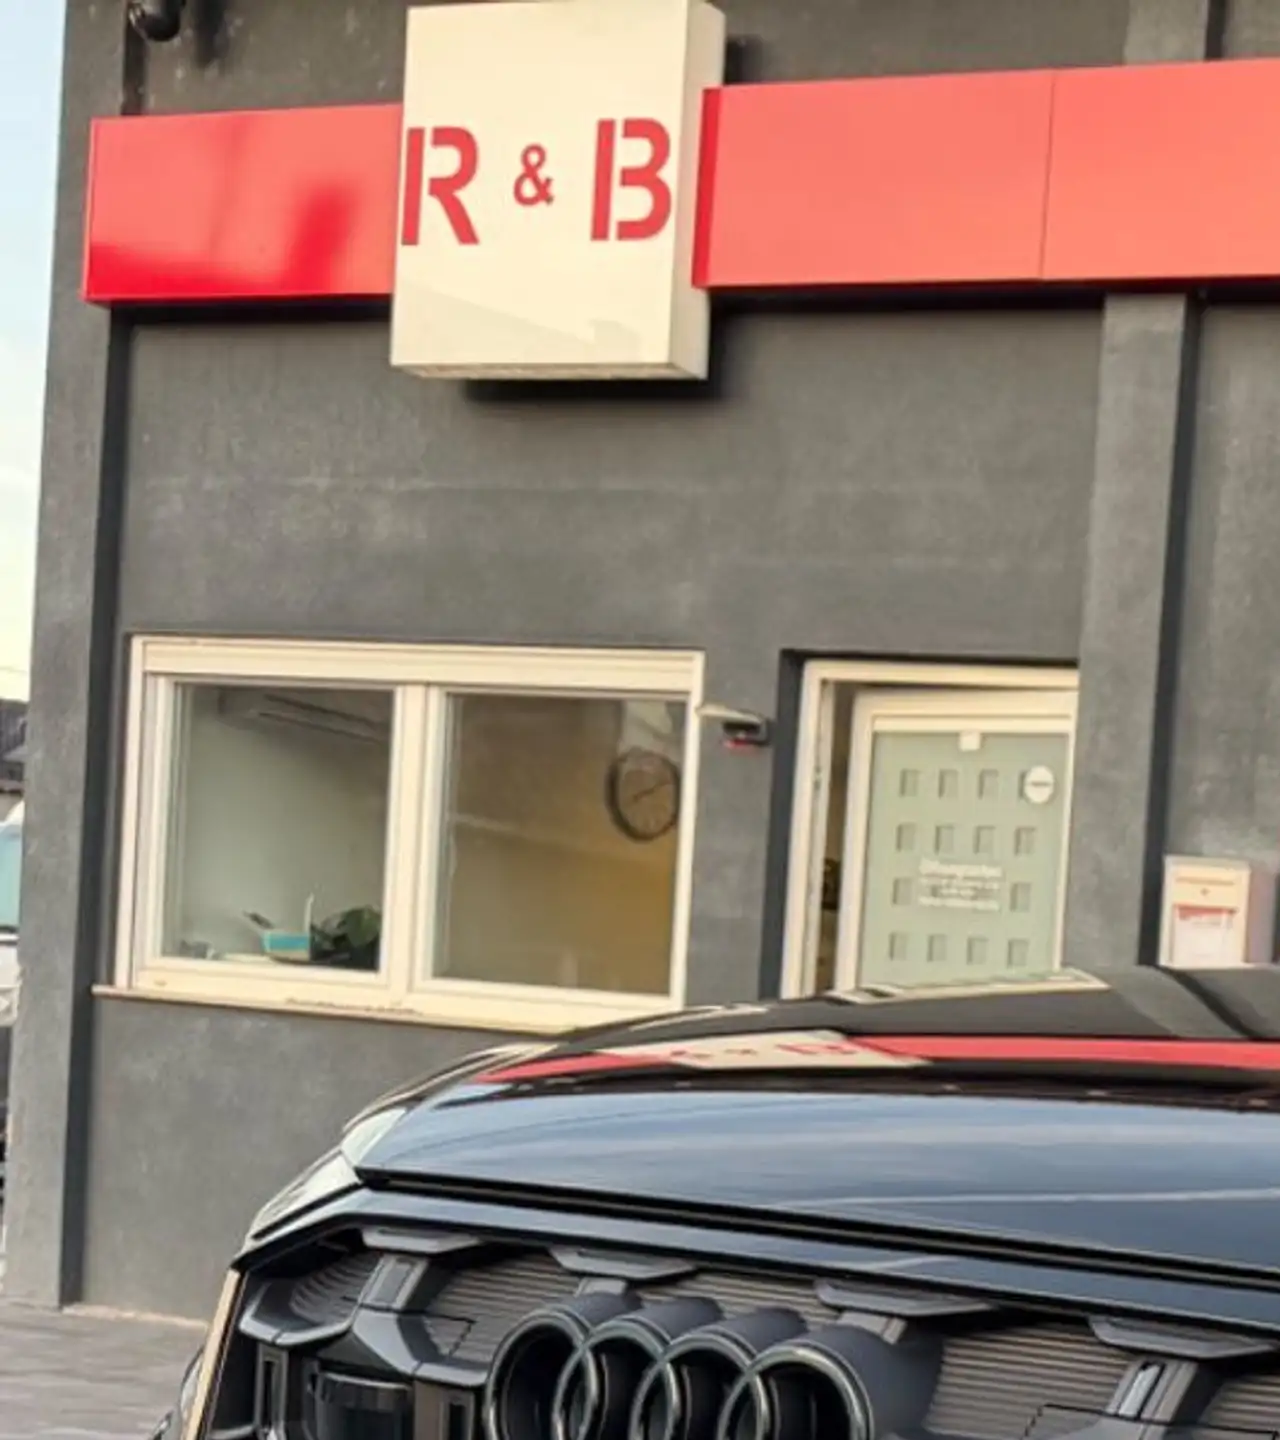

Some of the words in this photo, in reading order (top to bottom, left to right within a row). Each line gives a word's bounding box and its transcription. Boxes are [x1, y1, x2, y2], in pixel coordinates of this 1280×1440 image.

[401, 127, 480, 246] R
[513, 144, 555, 206] &
[590, 118, 671, 242] B
